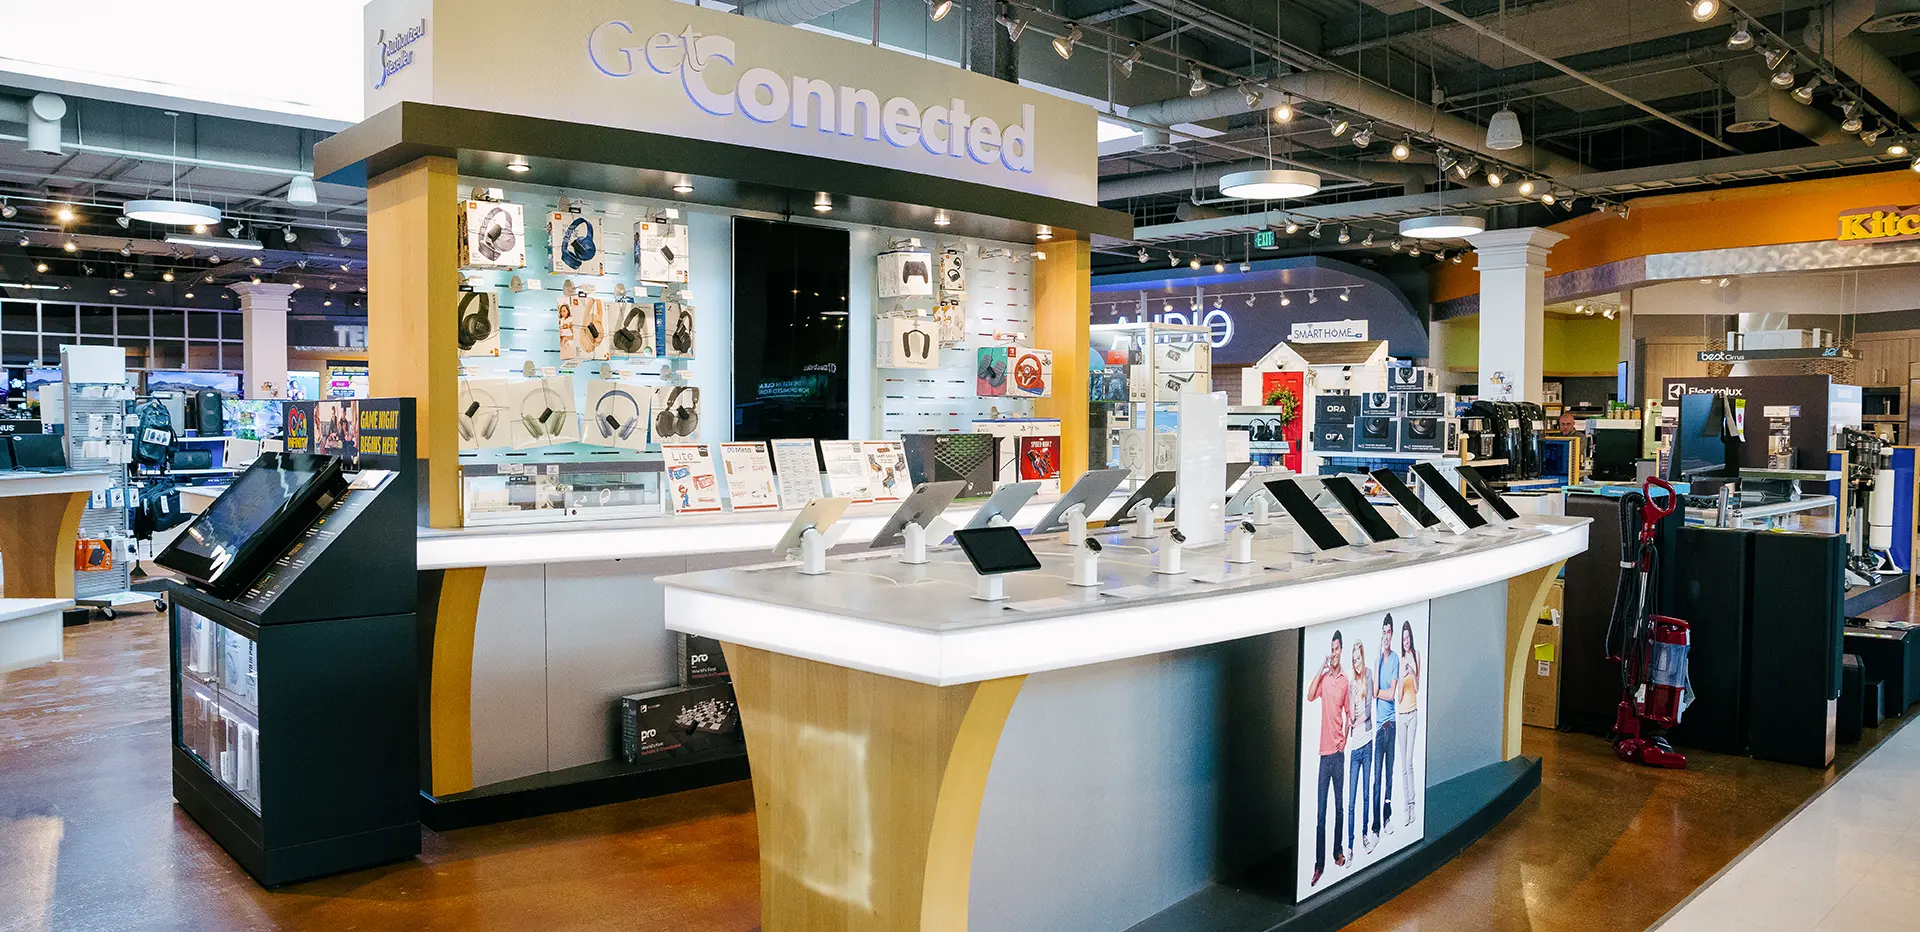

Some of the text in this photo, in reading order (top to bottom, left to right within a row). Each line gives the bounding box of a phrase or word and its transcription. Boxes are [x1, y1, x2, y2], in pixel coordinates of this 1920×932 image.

[588, 20, 707, 77] Get
[680, 34, 1035, 173] Connected
[1256, 231, 1272, 247] EXIT
[1294, 327, 1352, 340] SMART HOME
[1701, 352, 1725, 361] best
[1689, 387, 1742, 397] Electrolux
[1327, 405, 1346, 413] ORA
[360, 410, 399, 430] GAME NIGHT
[360, 436, 399, 456] BEGINS HERE
[672, 451, 694, 461] Lite
[691, 653, 708, 666] pro
[641, 728, 656, 742] pro
